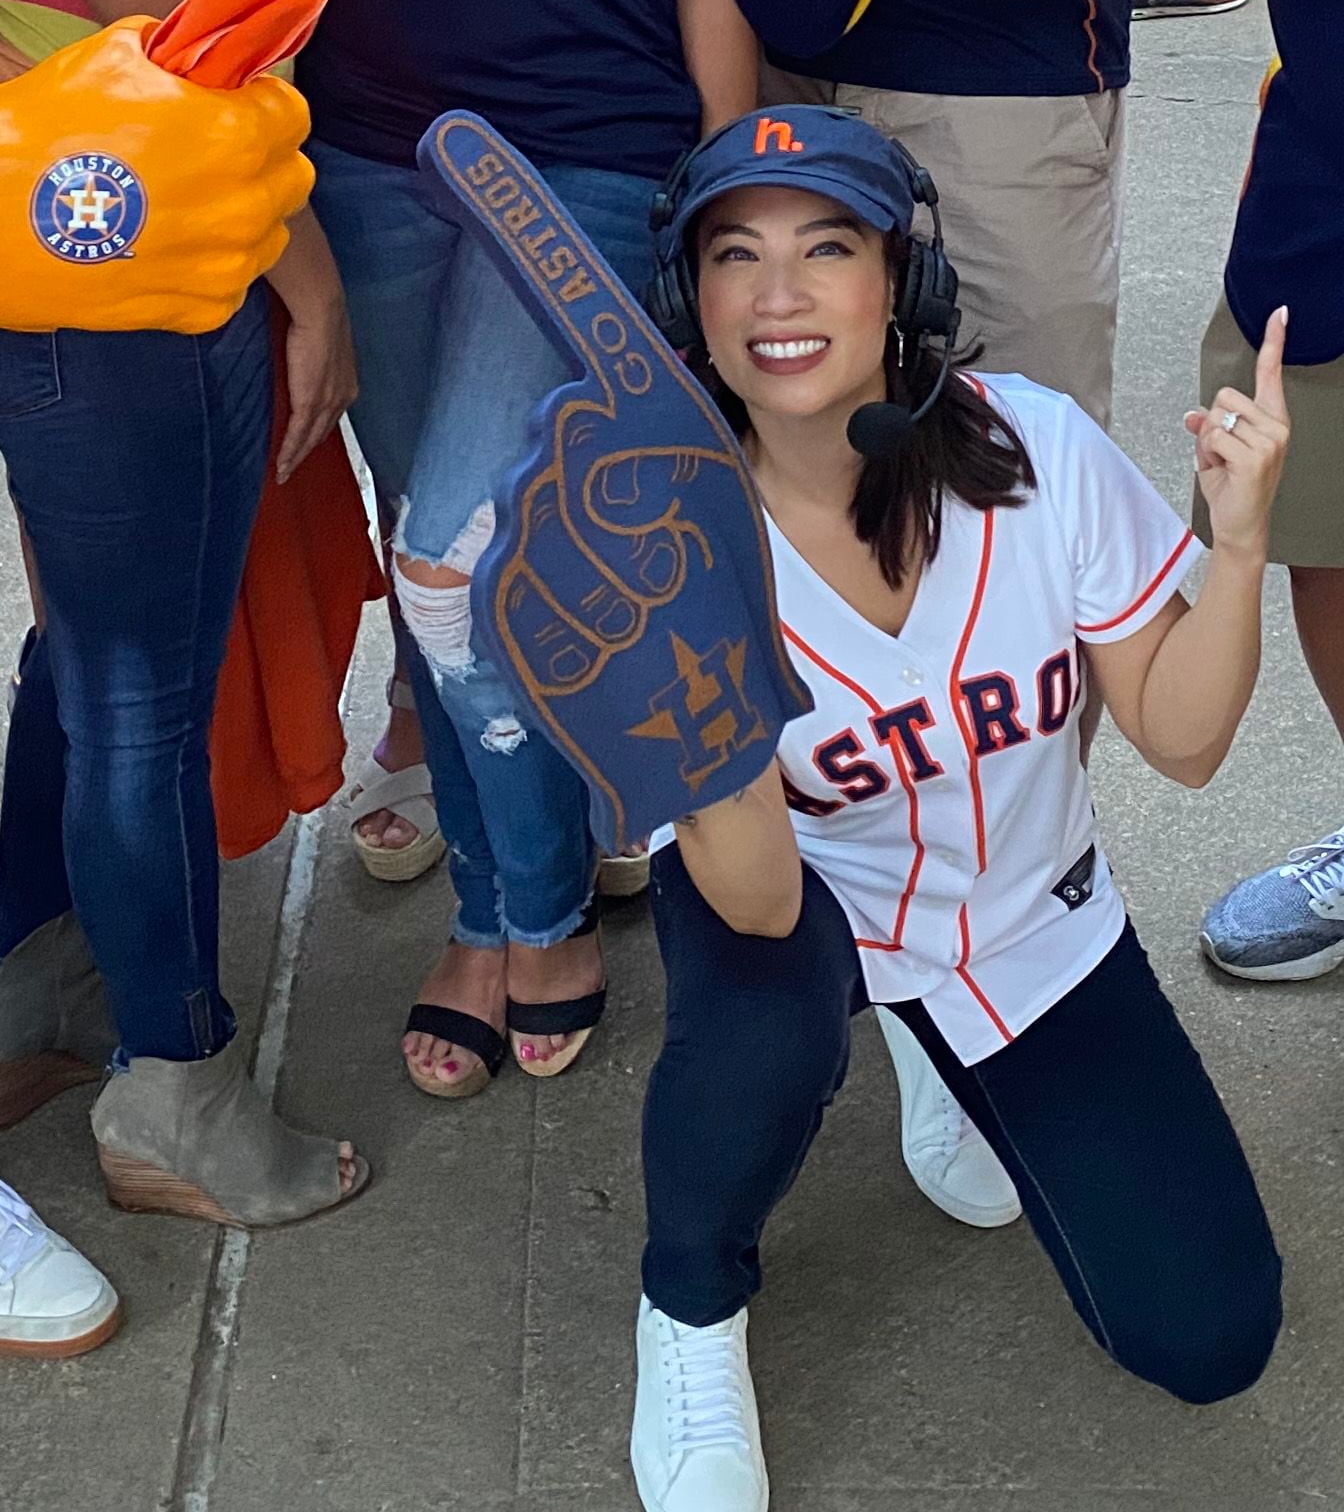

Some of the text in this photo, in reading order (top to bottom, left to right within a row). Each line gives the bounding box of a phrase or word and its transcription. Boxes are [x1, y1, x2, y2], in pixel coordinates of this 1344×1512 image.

[47, 156, 135, 189] HOUSTON
[67, 189, 111, 229] H
[47, 232, 126, 259] ASTROS
[466, 153, 653, 396] GO ASTROS
[779, 648, 1081, 817] STRO
